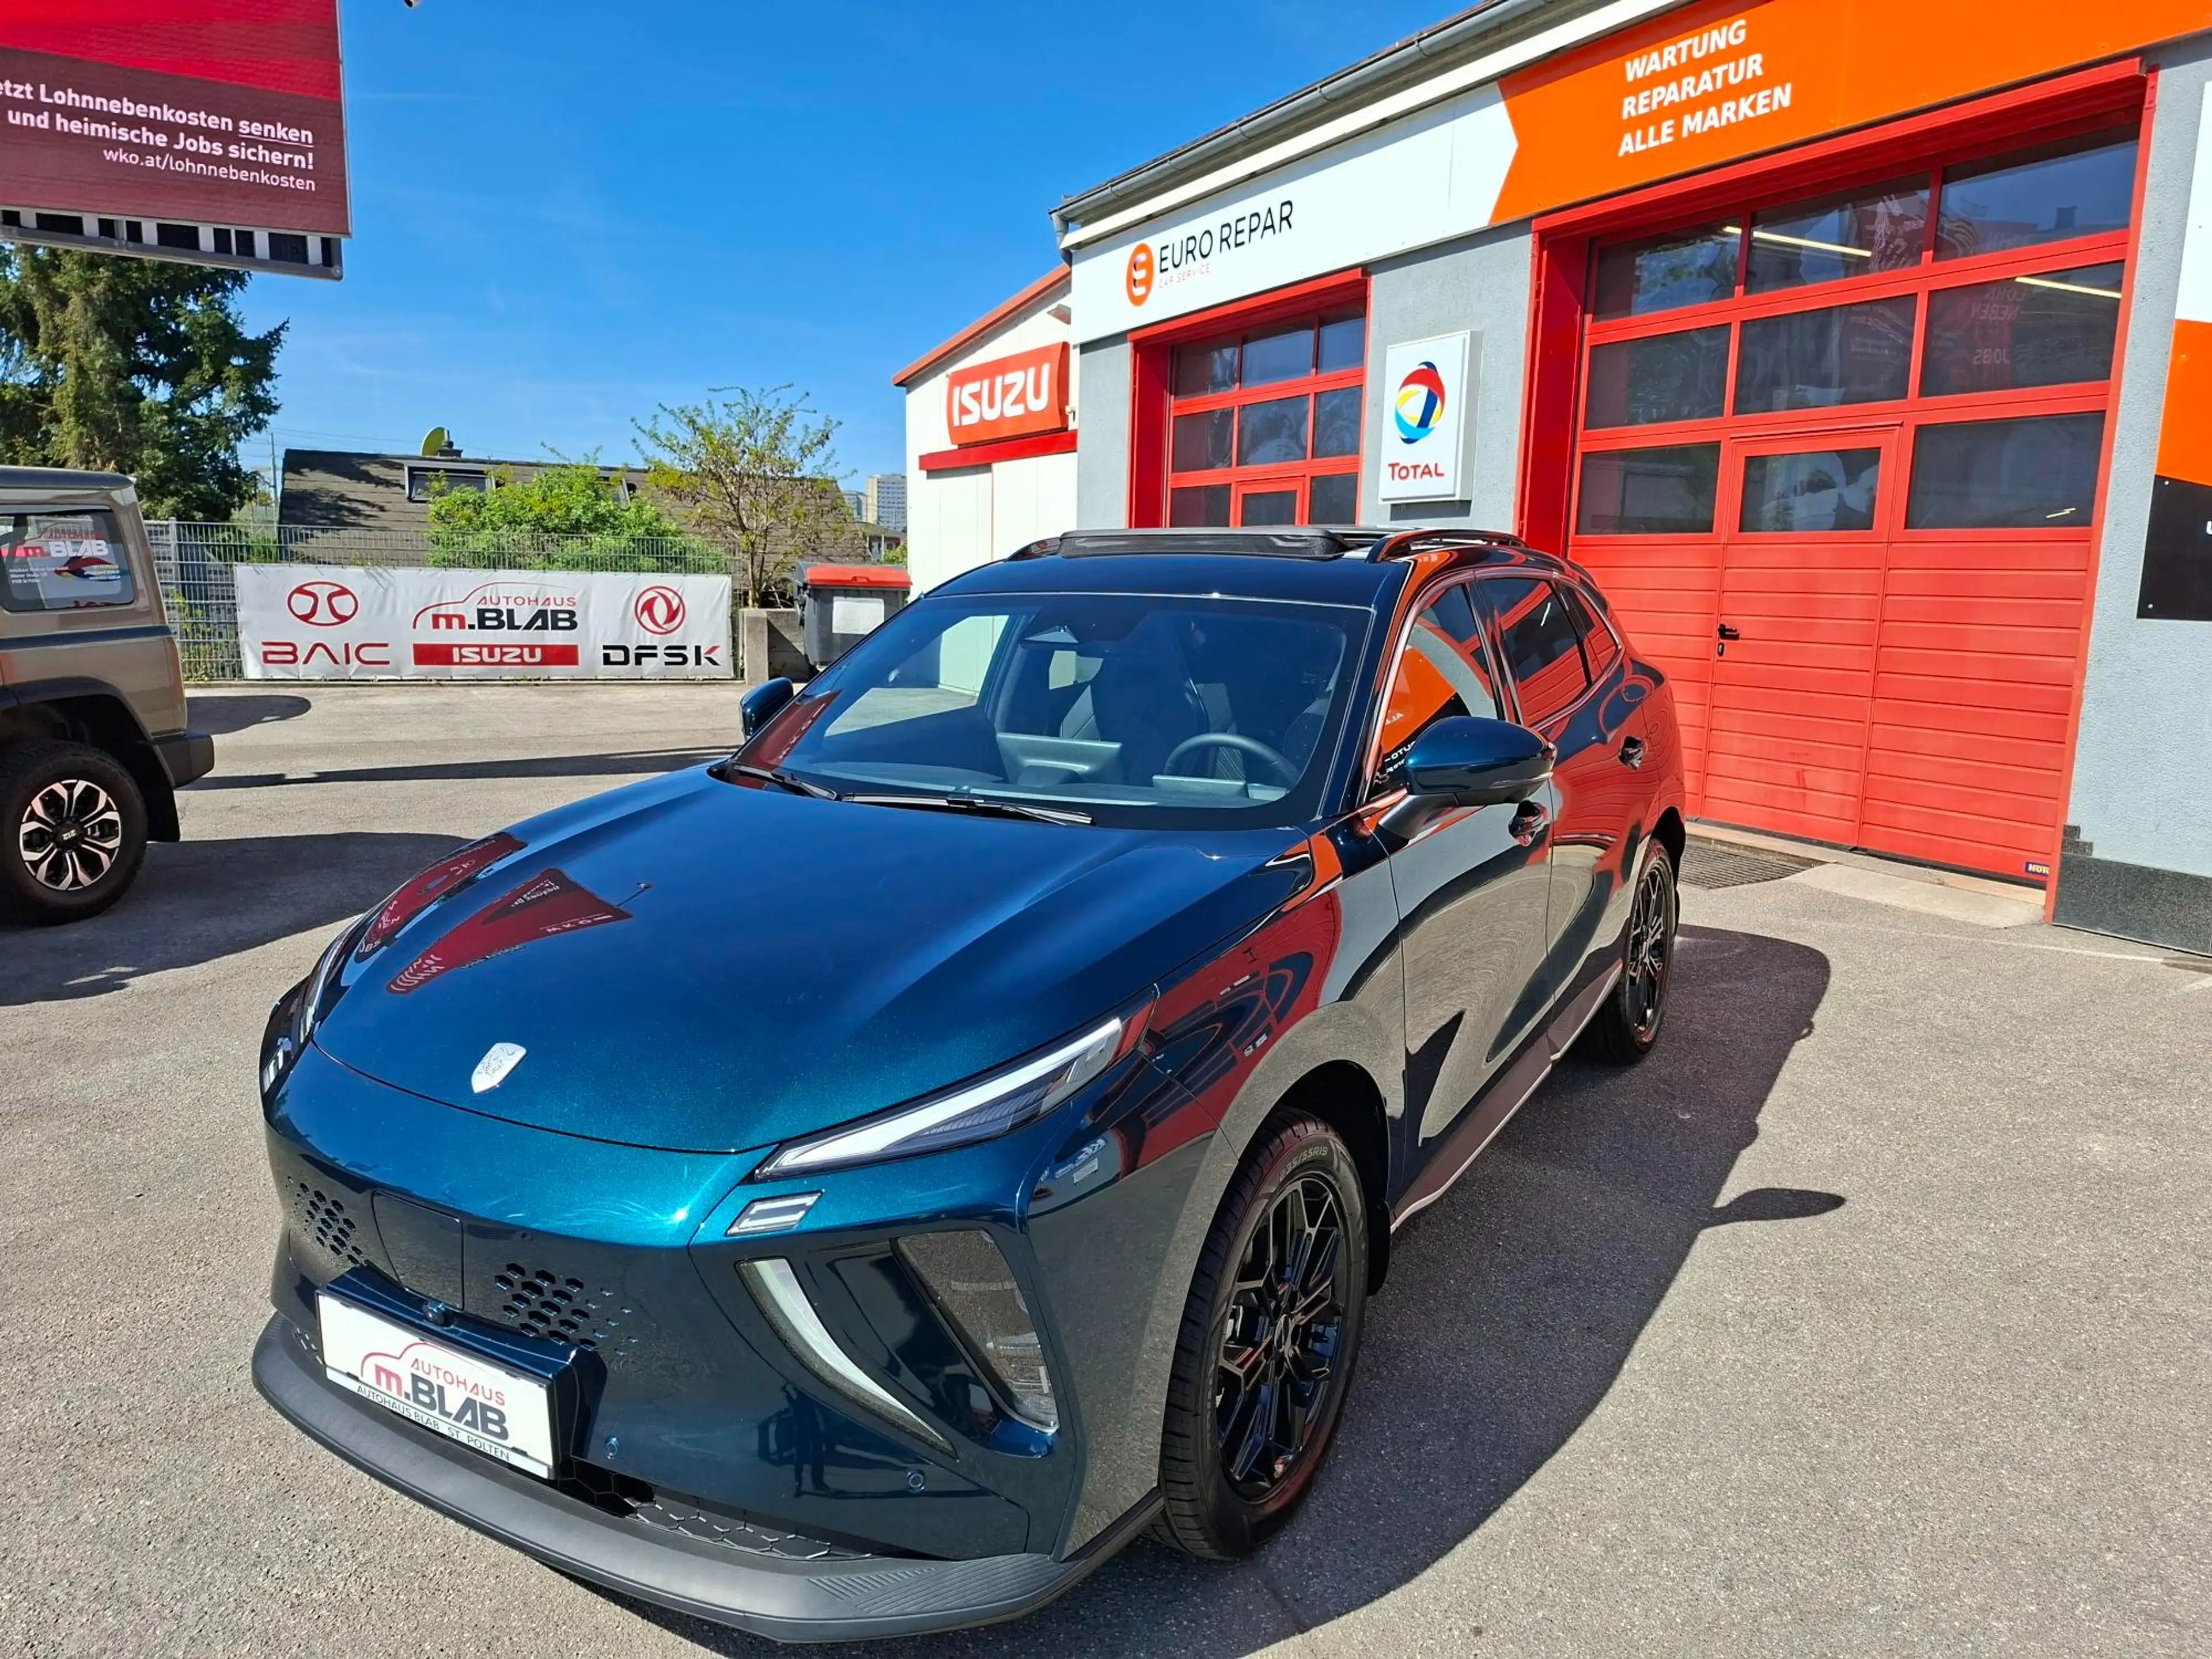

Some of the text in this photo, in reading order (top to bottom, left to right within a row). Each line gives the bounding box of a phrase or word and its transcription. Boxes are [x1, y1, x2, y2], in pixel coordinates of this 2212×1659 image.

[1624, 19, 1747, 82] WARTUNG
[1622, 53, 1763, 119] REPARATUR
[0, 79, 313, 144] tzt Lohnnebenkosten senken
[1618, 83, 1792, 157] ALLE MARKEN
[7, 110, 315, 169] und heimische Jobs sichern!
[103, 148, 316, 191] wko.at/lohnnebenkosten
[1159, 200, 1293, 274] EURO REPAR
[952, 362, 1051, 427] ISUZU
[1388, 462, 1445, 480] TOTAL
[477, 596, 576, 607] AUTOHAUS
[261, 641, 391, 665] BAIC
[453, 647, 541, 663] ISUZU
[602, 645, 721, 666] DFSK
[411, 1358, 505, 1406] AUTOHAUS
[357, 1385, 412, 1417] AUTOHAUS
[414, 1411, 440, 1430] BLAB
